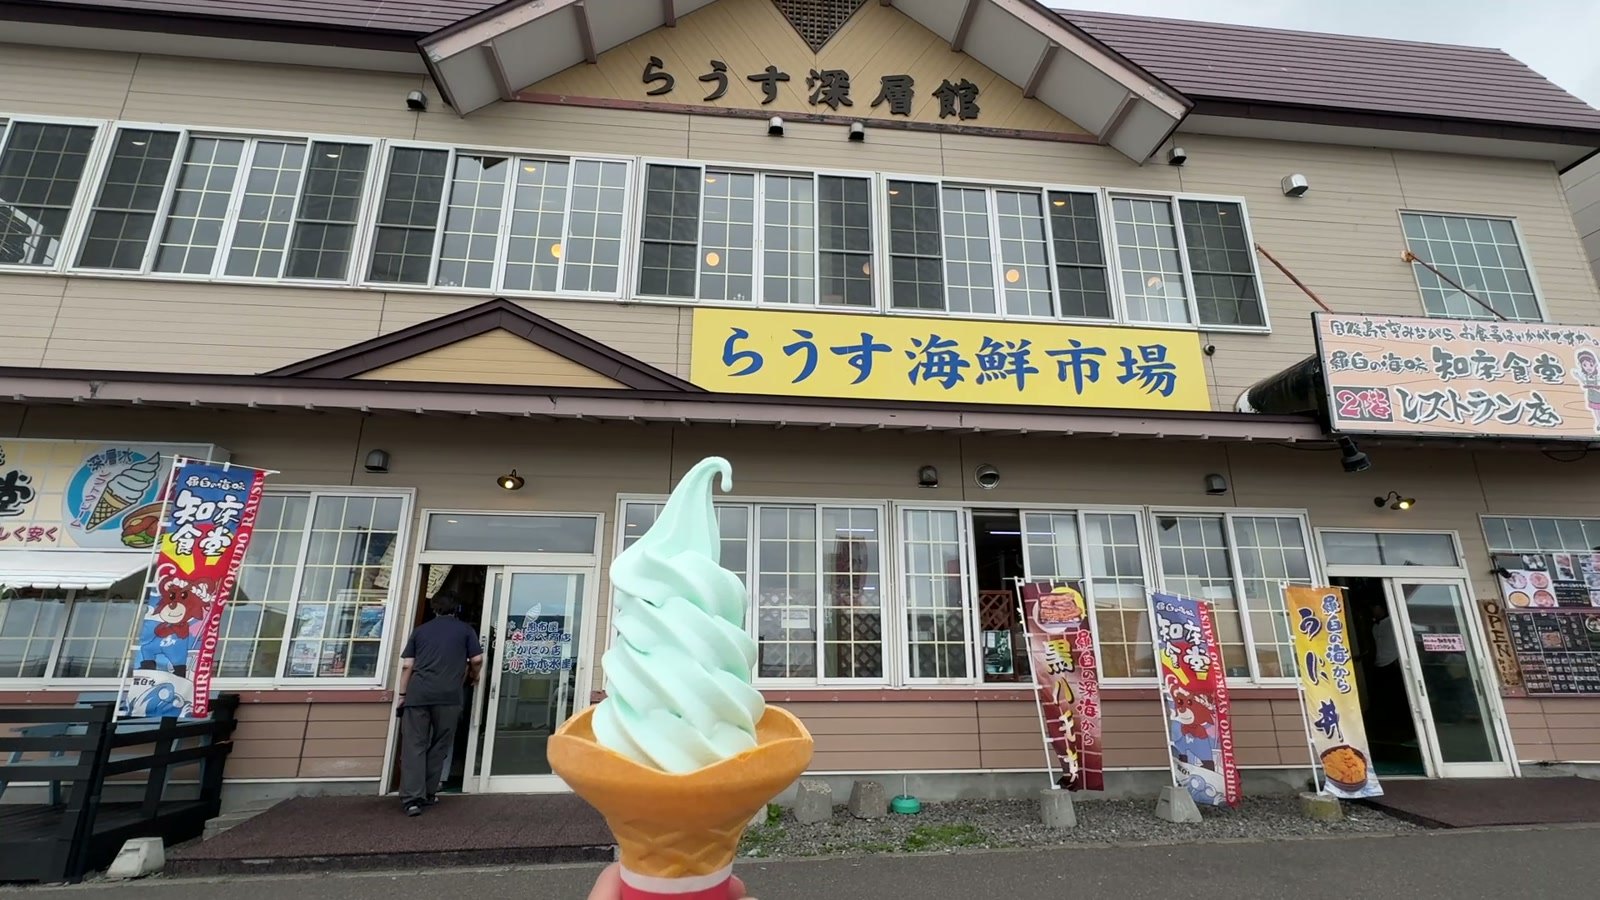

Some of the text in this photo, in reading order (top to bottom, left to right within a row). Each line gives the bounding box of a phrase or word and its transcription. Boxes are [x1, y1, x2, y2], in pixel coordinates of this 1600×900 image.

[642, 56, 980, 121] らうす深層館
[722, 327, 1177, 398] らうす海鮮市場
[1431, 347, 1566, 384] 知床食堂
[1337, 389, 1392, 421] 2階
[1395, 388, 1563, 427] レストラン店
[87, 448, 134, 472] 深層水
[175, 490, 245, 525] 知床
[172, 521, 232, 556] 食堂
[194, 612, 221, 715] SHIRETOKO
[1219, 719, 1238, 804] SHIRETOKO
